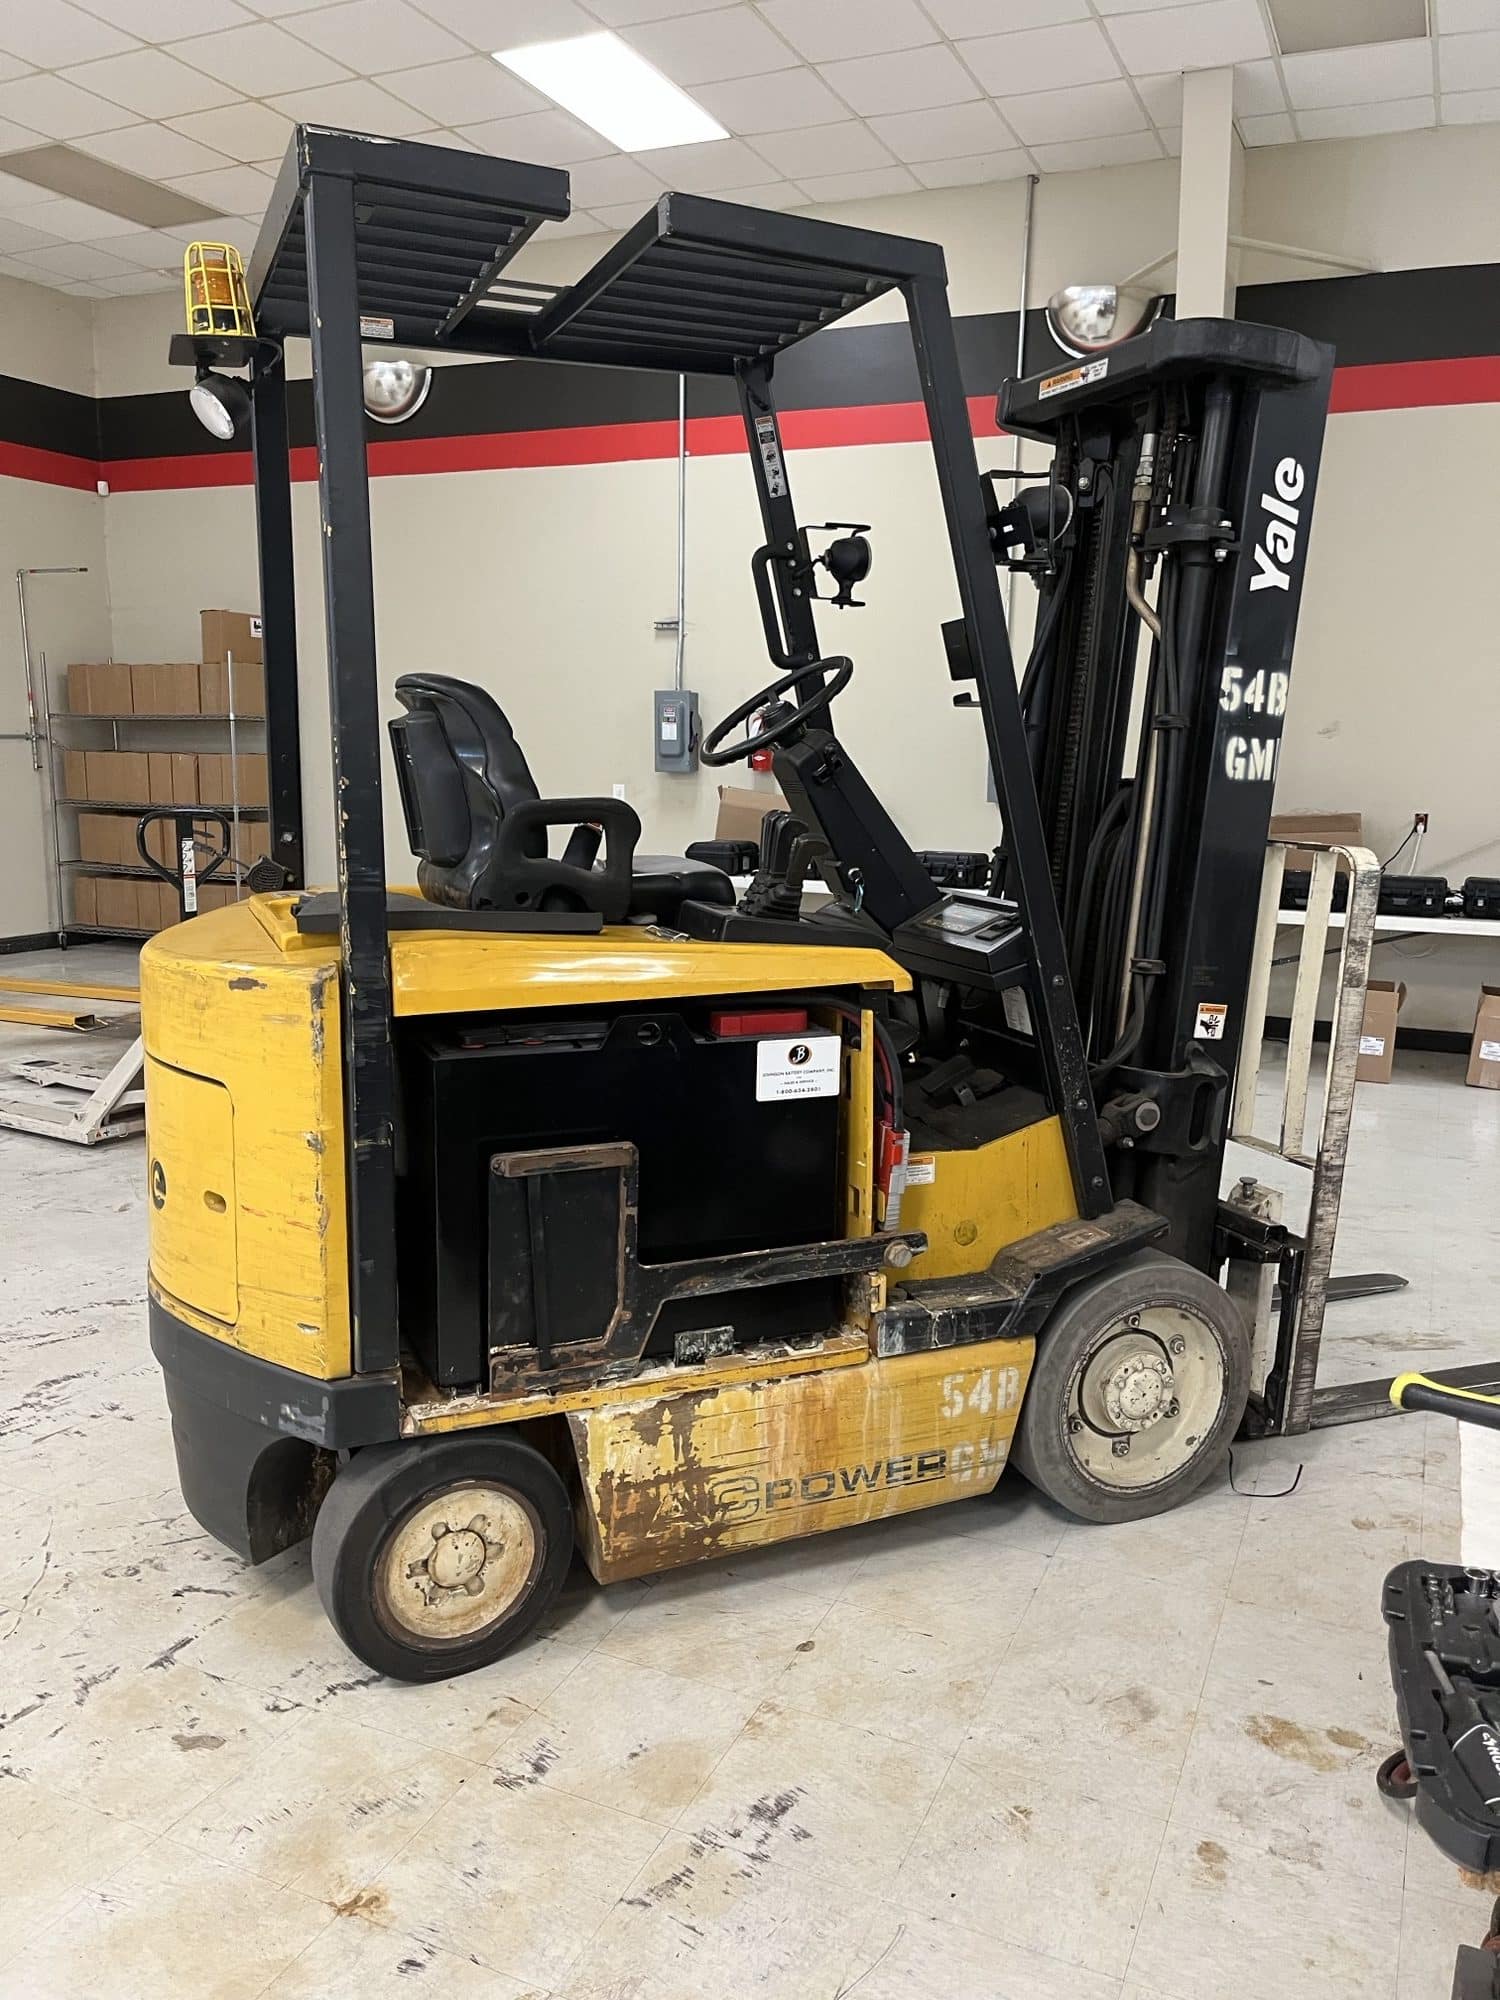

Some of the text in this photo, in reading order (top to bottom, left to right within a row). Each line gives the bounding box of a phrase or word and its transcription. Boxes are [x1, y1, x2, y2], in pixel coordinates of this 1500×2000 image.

[1250, 457, 1304, 591] Yale
[1218, 666, 1289, 716] 54B
[1225, 735, 1275, 781] GM
[941, 1366, 1020, 1419] 54B
[765, 1449, 947, 1509] POWER
